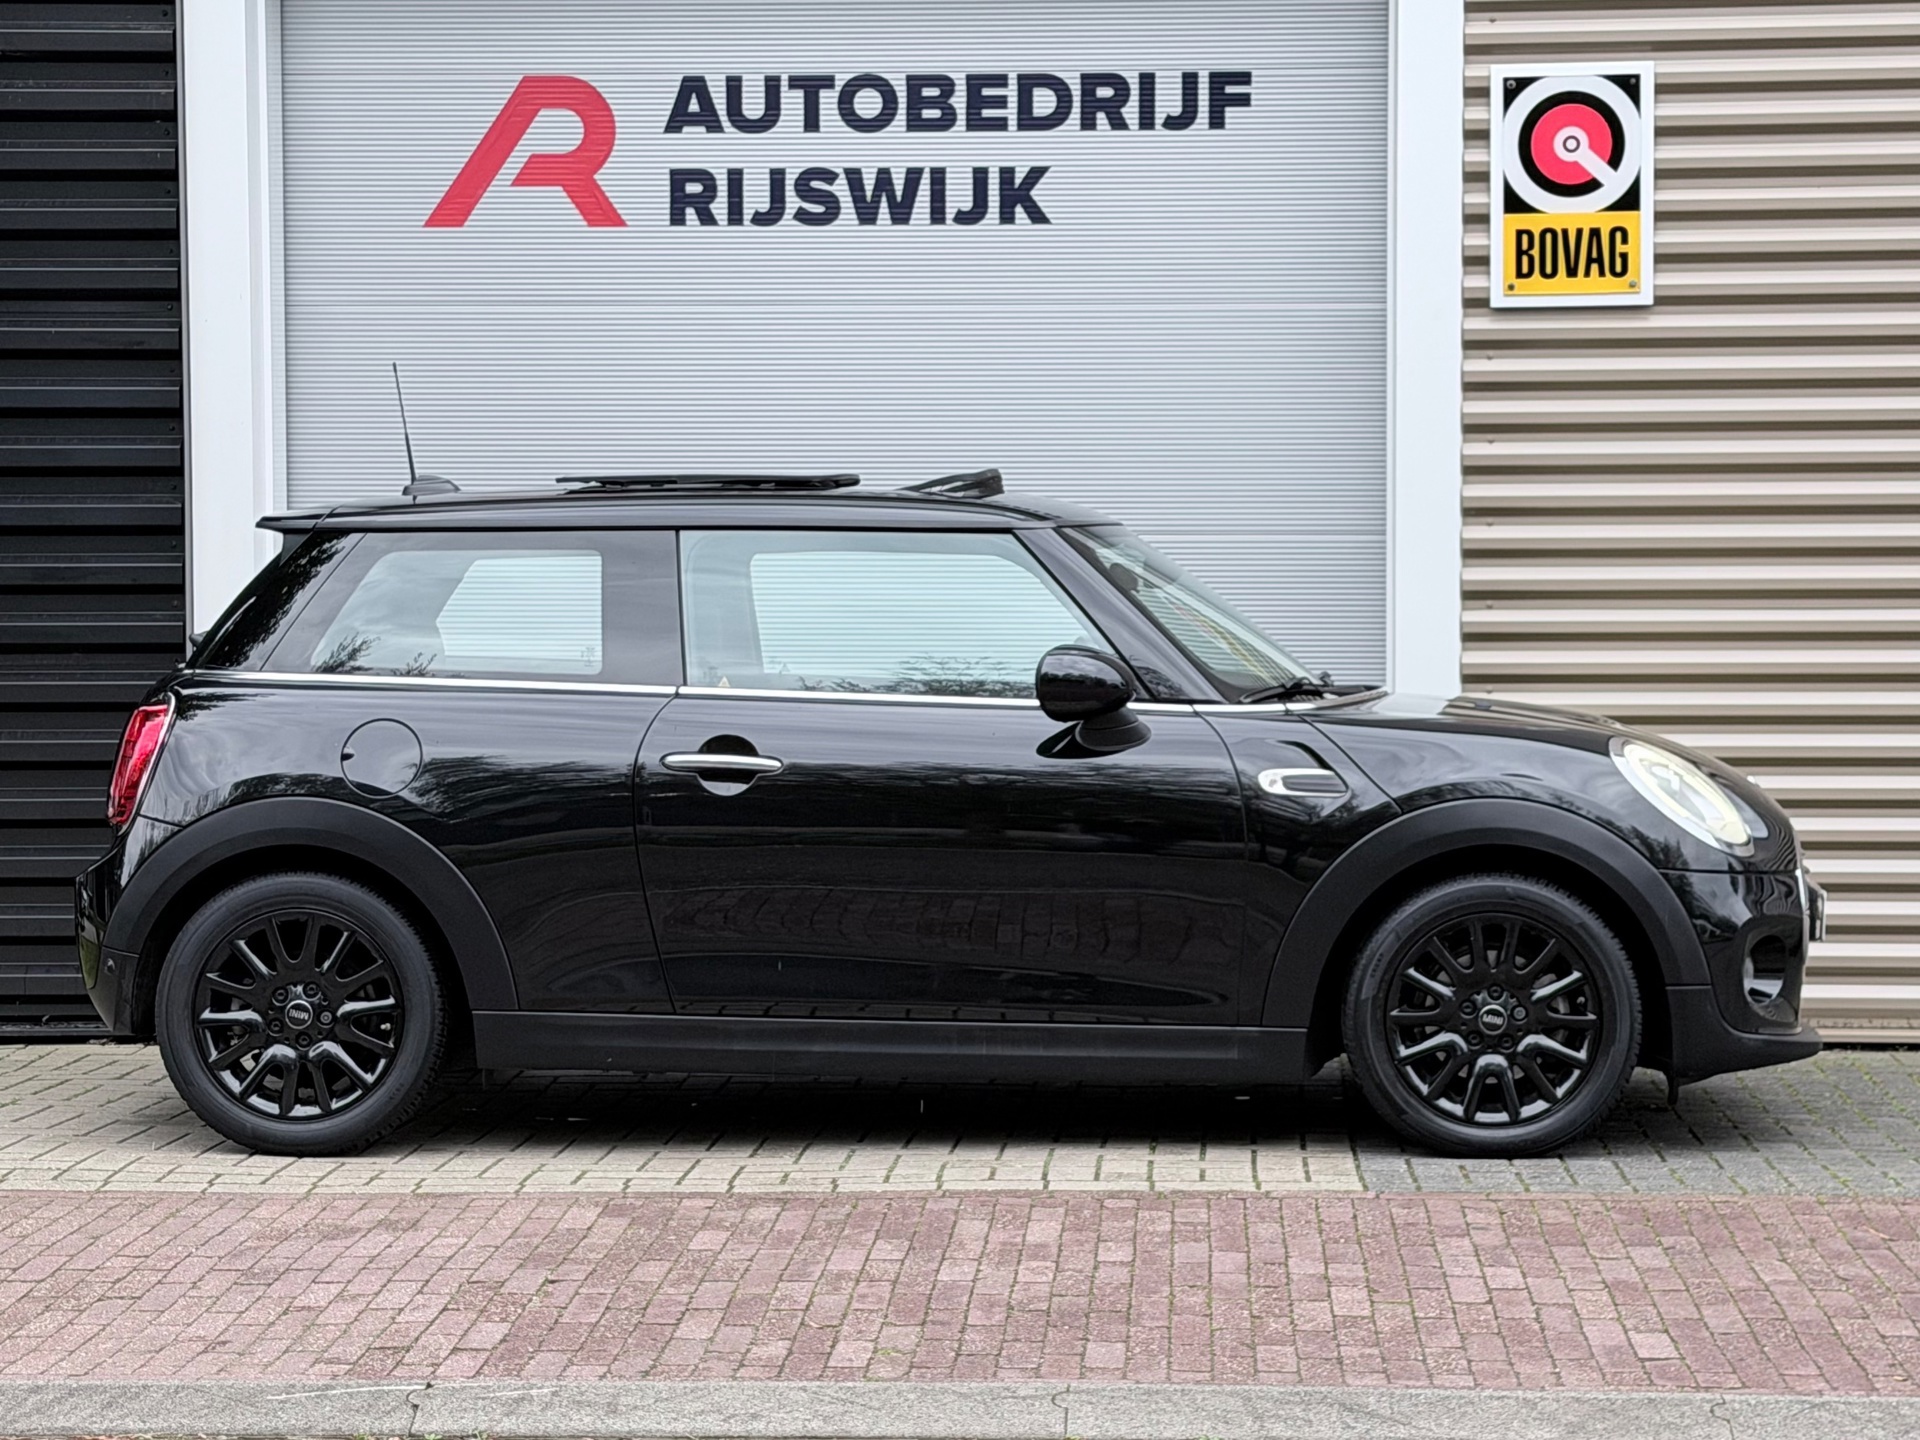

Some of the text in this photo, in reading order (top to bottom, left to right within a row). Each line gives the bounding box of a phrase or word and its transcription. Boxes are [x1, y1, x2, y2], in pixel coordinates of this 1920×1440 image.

[664, 71, 1252, 133] AUTOBEDRIJF
[669, 166, 1051, 226] RIJSWIJK
[1515, 225, 1629, 279] BOVAG
